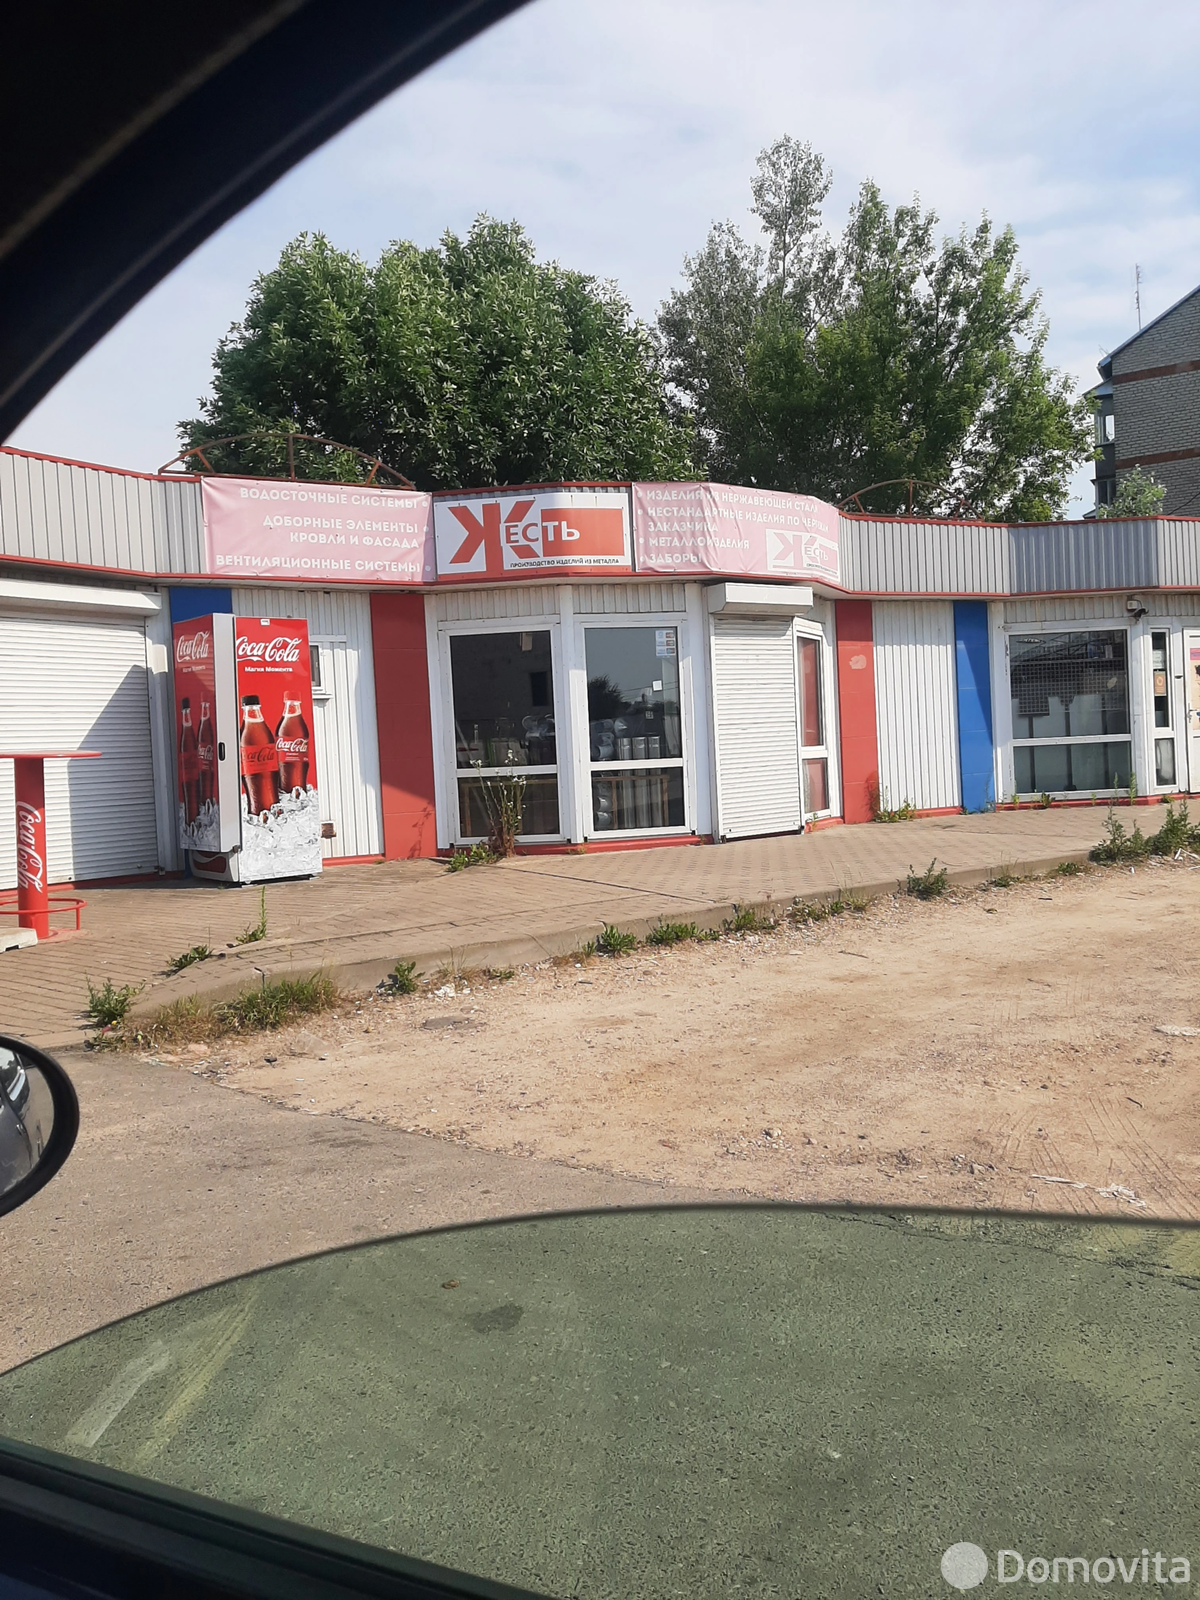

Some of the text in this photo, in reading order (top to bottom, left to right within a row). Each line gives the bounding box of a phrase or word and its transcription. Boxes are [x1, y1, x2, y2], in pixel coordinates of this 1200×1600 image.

[240, 487, 417, 509] ВОДОСТОЧНЫЕ СИСТЕМЫ
[646, 490, 703, 501] ИЗДЕЛИЯ
[722, 492, 792, 510] НЕРЖАВЕЮЩЕЙ
[262, 515, 418, 534] ДОБОРНЫЕ ЭЛЕМЕНТЫ
[647, 506, 743, 520] НЕСТАНДАРТНЫЕ
[745, 511, 785, 524] ИЗДЕЛИЯ
[787, 515, 800, 526] ПО
[648, 521, 718, 532] ЗАКАЗЧИКА
[290, 532, 419, 548] КРОВЛИ И ФАСАДА
[649, 536, 749, 549] МЕТАЛЛОИЗДЕЛИЯ
[216, 554, 420, 573] ВЕНТИЛЯЦИОННЫЕ СИСТЕМЫ
[510, 559, 555, 568] ПРОИЗВОДСТВО
[649, 553, 702, 563] ЗАБОРЫ
[236, 636, 303, 662] Coca-Cola
